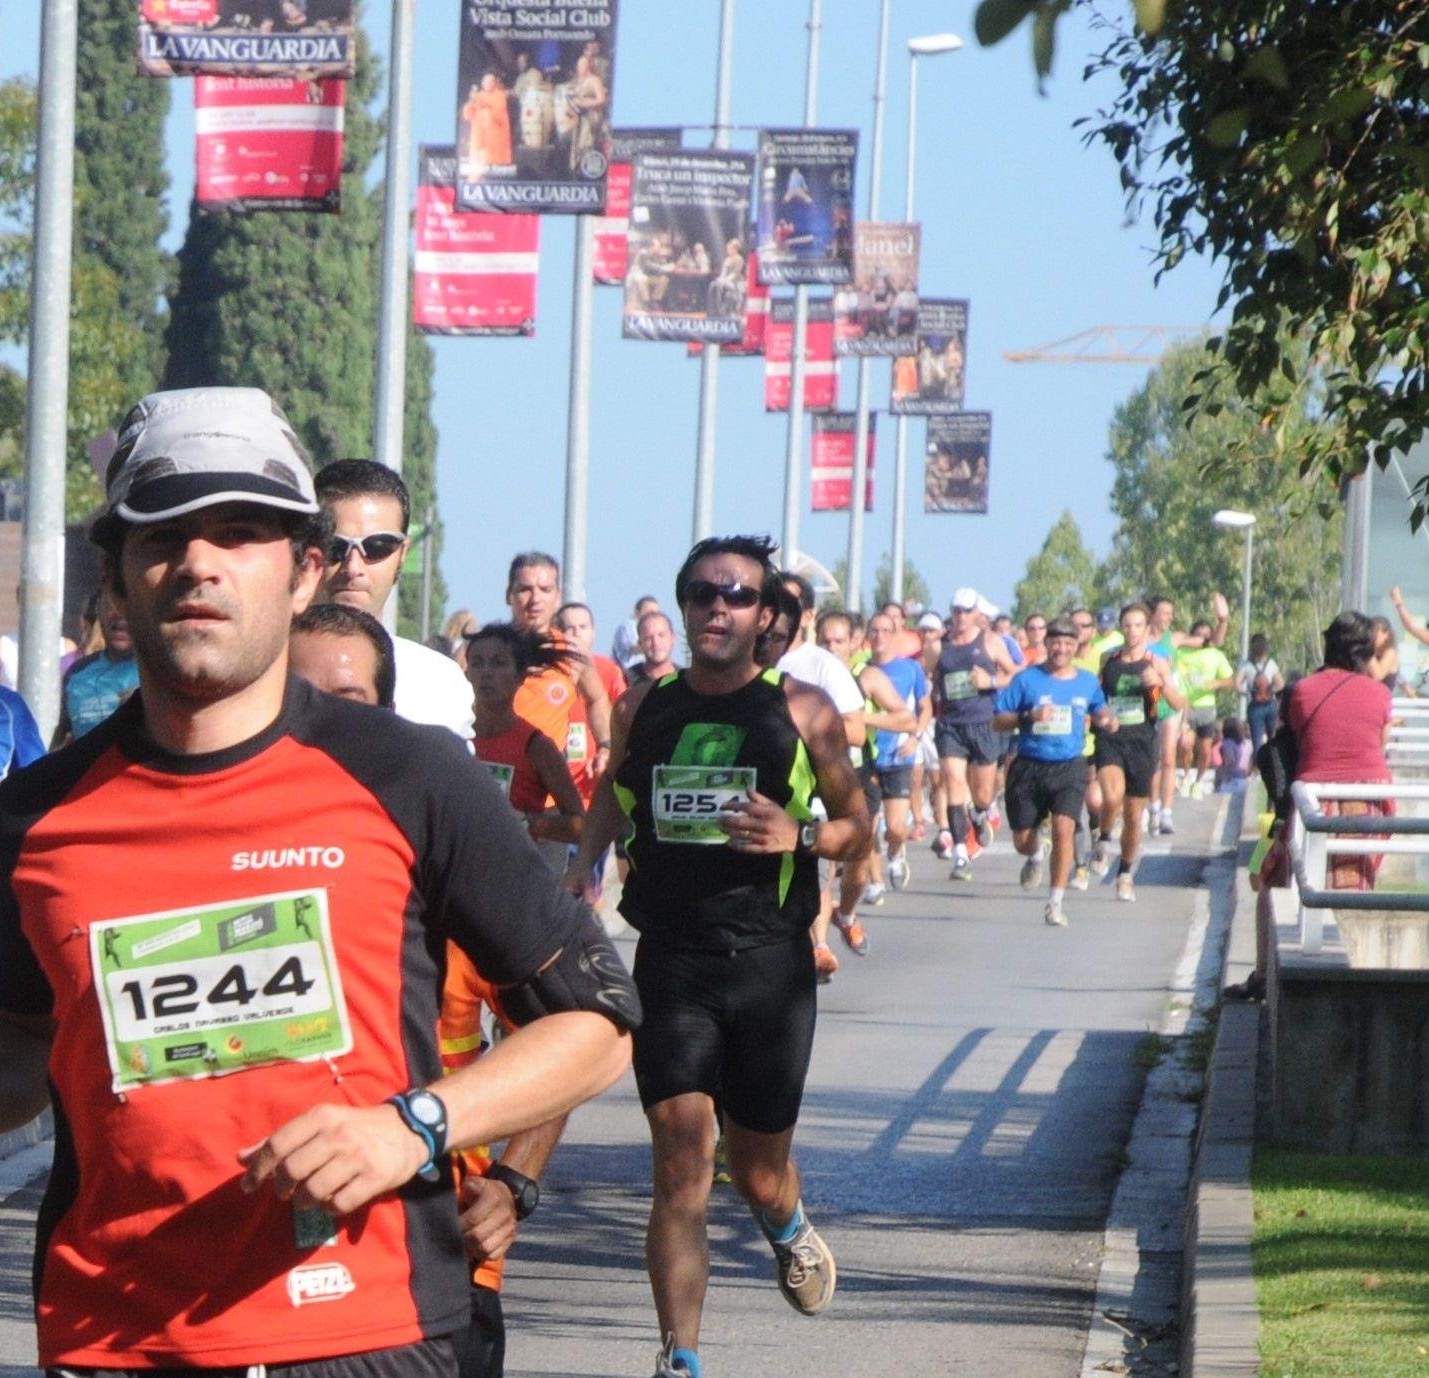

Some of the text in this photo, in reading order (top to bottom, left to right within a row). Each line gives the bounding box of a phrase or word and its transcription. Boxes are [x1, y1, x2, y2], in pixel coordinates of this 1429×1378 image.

[470, 8, 611, 27] Vista Social Club
[148, 36, 342, 60] LA VANGUARDIA
[463, 185, 484, 202] LA
[485, 185, 600, 202] VANGUARDIA
[647, 317, 738, 334] VANGUARDIA
[231, 846, 345, 871] SUUNTO
[121, 955, 316, 1021] 1244
